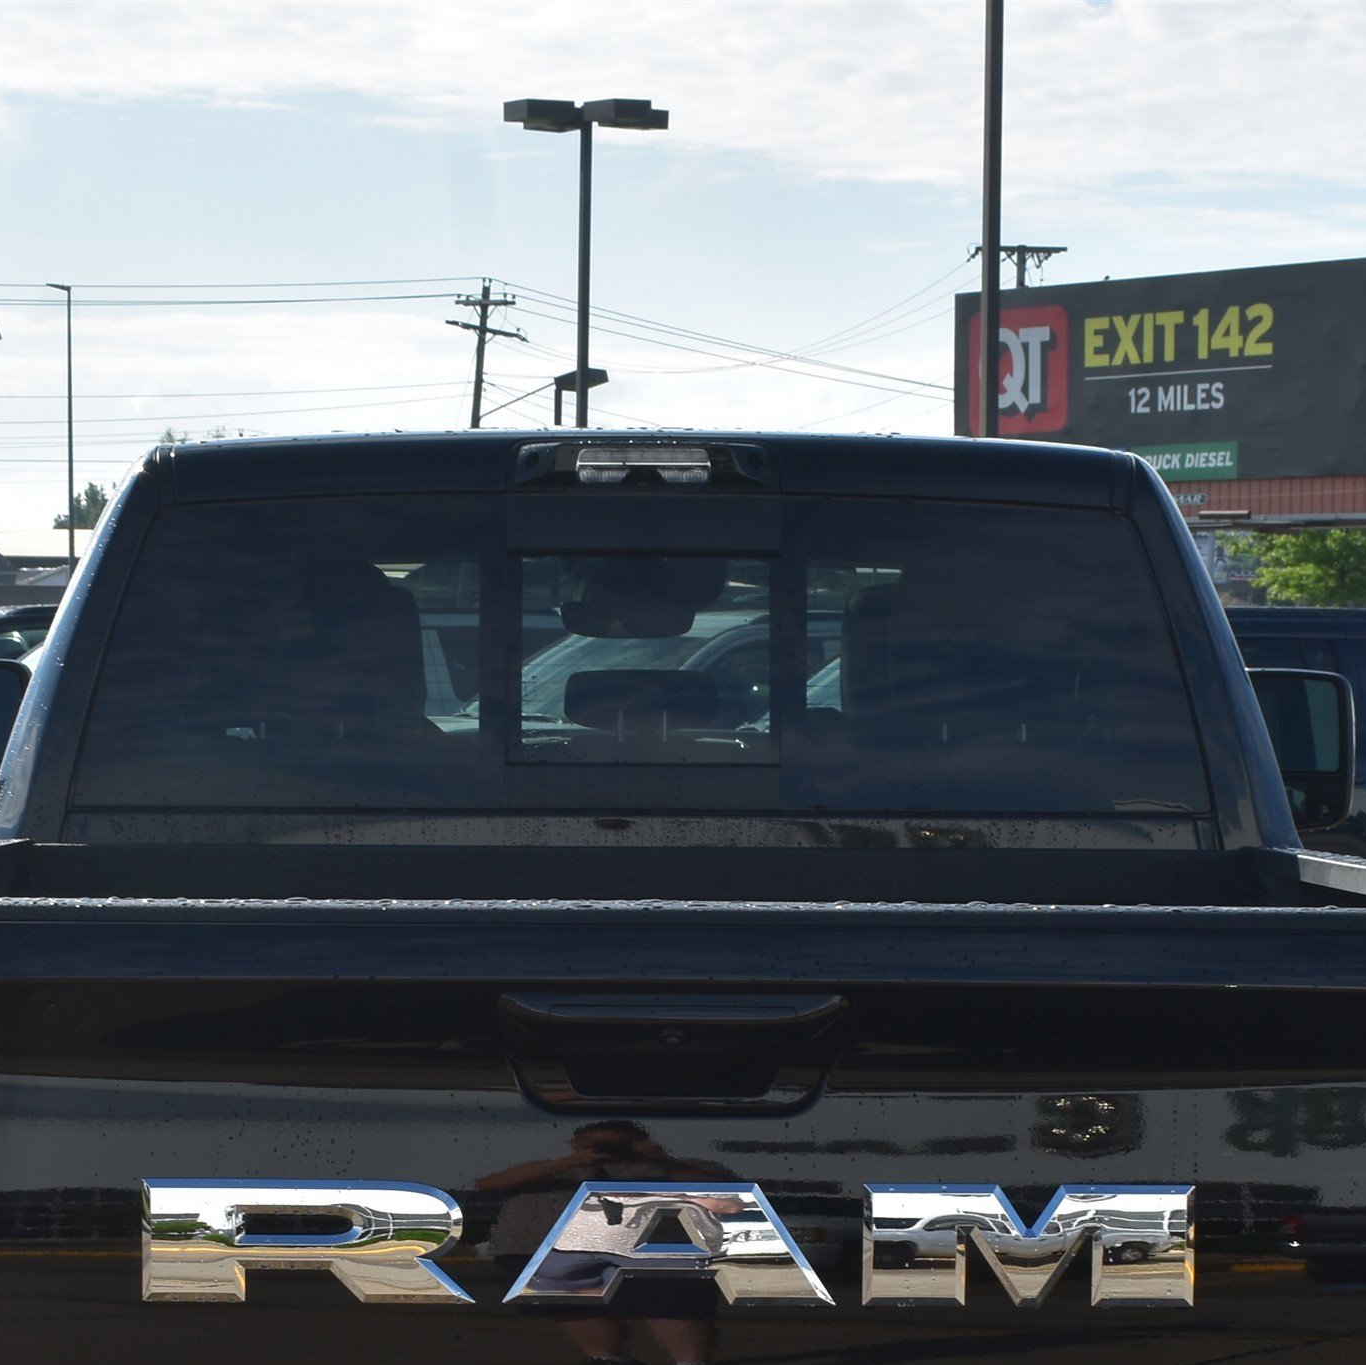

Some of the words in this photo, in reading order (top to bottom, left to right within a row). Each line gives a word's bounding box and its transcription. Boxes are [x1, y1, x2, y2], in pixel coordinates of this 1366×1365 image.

[1085, 311, 1184, 367] EXIT
[1193, 303, 1274, 359] 142
[1129, 387, 1151, 414] 12
[1158, 382, 1225, 412] MILES
[1144, 453, 1181, 470] RUCK
[1184, 451, 1234, 469] DIESEL
[141, 1177, 1197, 1307] RAM
